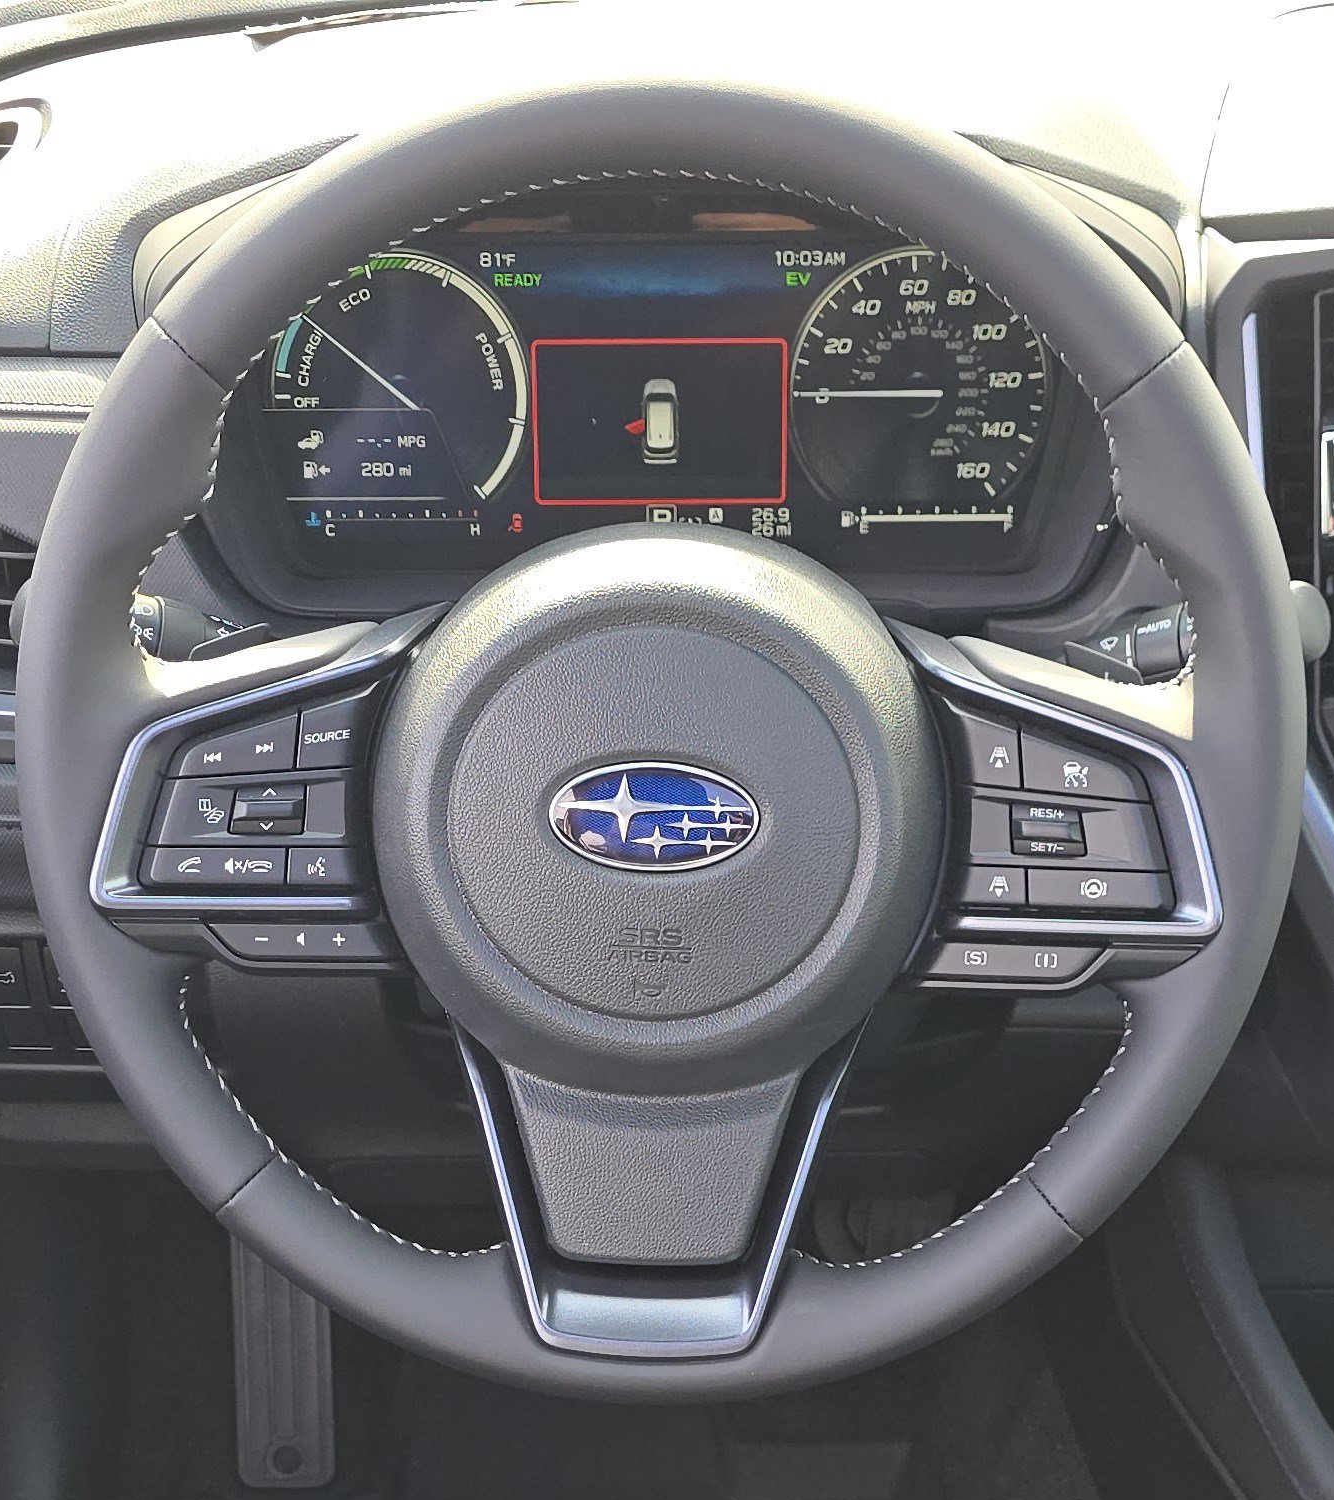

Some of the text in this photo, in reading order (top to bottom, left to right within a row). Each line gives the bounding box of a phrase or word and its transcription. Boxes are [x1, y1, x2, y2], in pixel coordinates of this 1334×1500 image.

[493, 273, 543, 288] READY
[785, 271, 812, 287] EV
[899, 279, 930, 296] 60
[338, 288, 373, 313] ECO
[946, 289, 977, 306] 80
[850, 299, 882, 316] 40
[905, 300, 937, 315] MPH
[971, 324, 1008, 341] 100
[823, 337, 853, 355] 20
[474, 332, 505, 392] POWER
[988, 371, 1023, 388] 120
[293, 396, 320, 409] OFF
[980, 421, 1017, 438] 140
[397, 435, 427, 449] MPG
[361, 462, 413, 478] 280 mi
[956, 462, 992, 479] 160
[751, 507, 791, 523] 26.9
[325, 523, 336, 538] C
[470, 523, 481, 537] H
[303, 728, 352, 746] SOURCE
[1029, 806, 1066, 820] RES/+
[617, 927, 683, 949] SRS
[606, 949, 694, 965] AIRBAG
